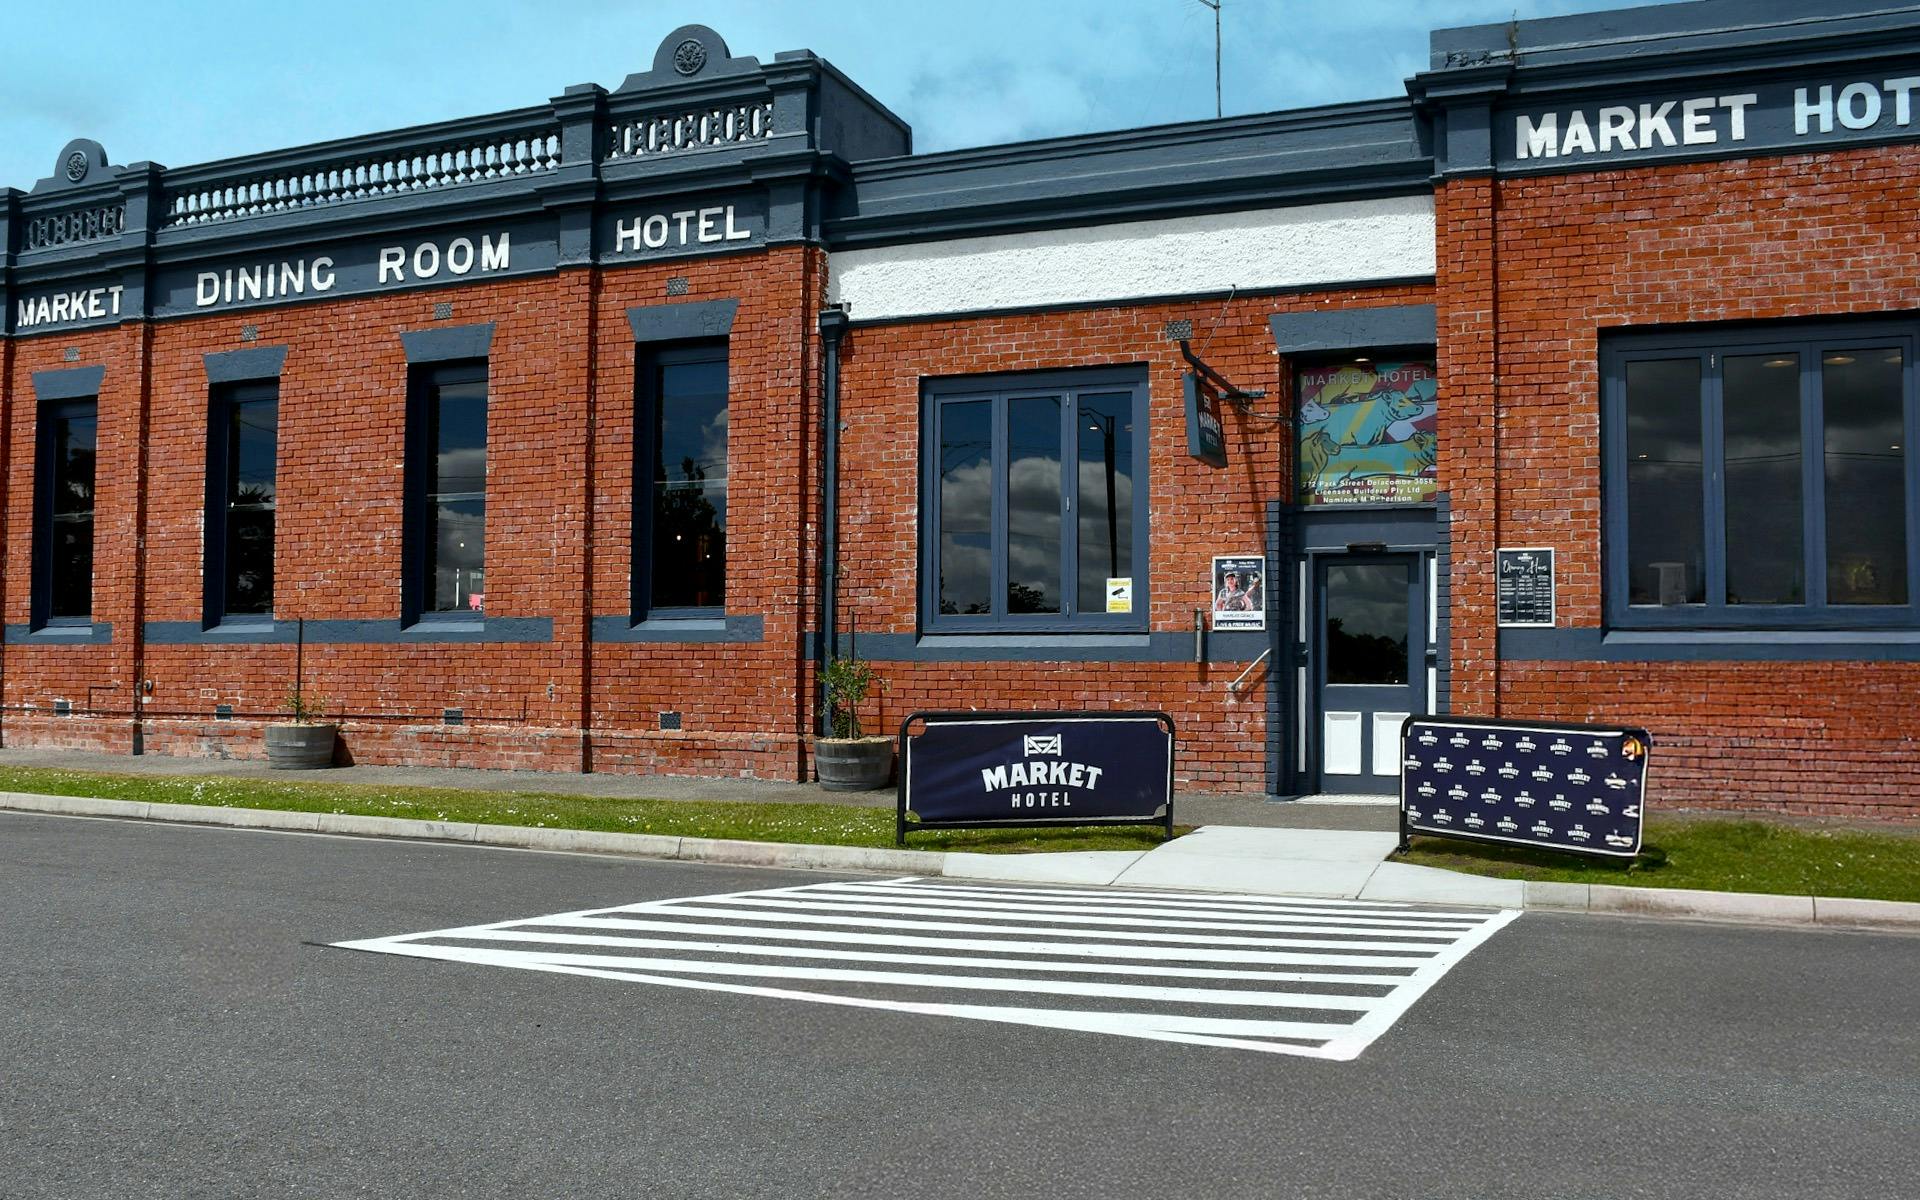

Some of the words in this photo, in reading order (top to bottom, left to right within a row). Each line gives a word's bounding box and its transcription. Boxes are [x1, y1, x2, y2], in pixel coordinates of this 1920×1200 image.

[1515, 92, 1758, 160] MARKET
[1793, 75, 1920, 136] HOT
[615, 205, 752, 253] HOTEL
[196, 256, 336, 307] DINING
[377, 231, 511, 284] ROOM
[16, 285, 124, 327] MARKET
[1303, 372, 1370, 386] MARKET
[1377, 370, 1431, 383] HOTEL
[1339, 479, 1364, 487] Street
[1516, 742, 1536, 750] MARKET
[1550, 744, 1572, 752] MARKET
[981, 761, 1103, 793] MARKET
[1567, 774, 1591, 782] MARKET
[1448, 789, 1468, 797] MARKET
[1481, 793, 1502, 801] MARKET
[1011, 791, 1071, 809] HOTEL
[1549, 800, 1572, 808] MARKET
[1433, 814, 1452, 822] MARKET
[1531, 826, 1553, 834] MARKET
[1567, 830, 1591, 838] MARKET
